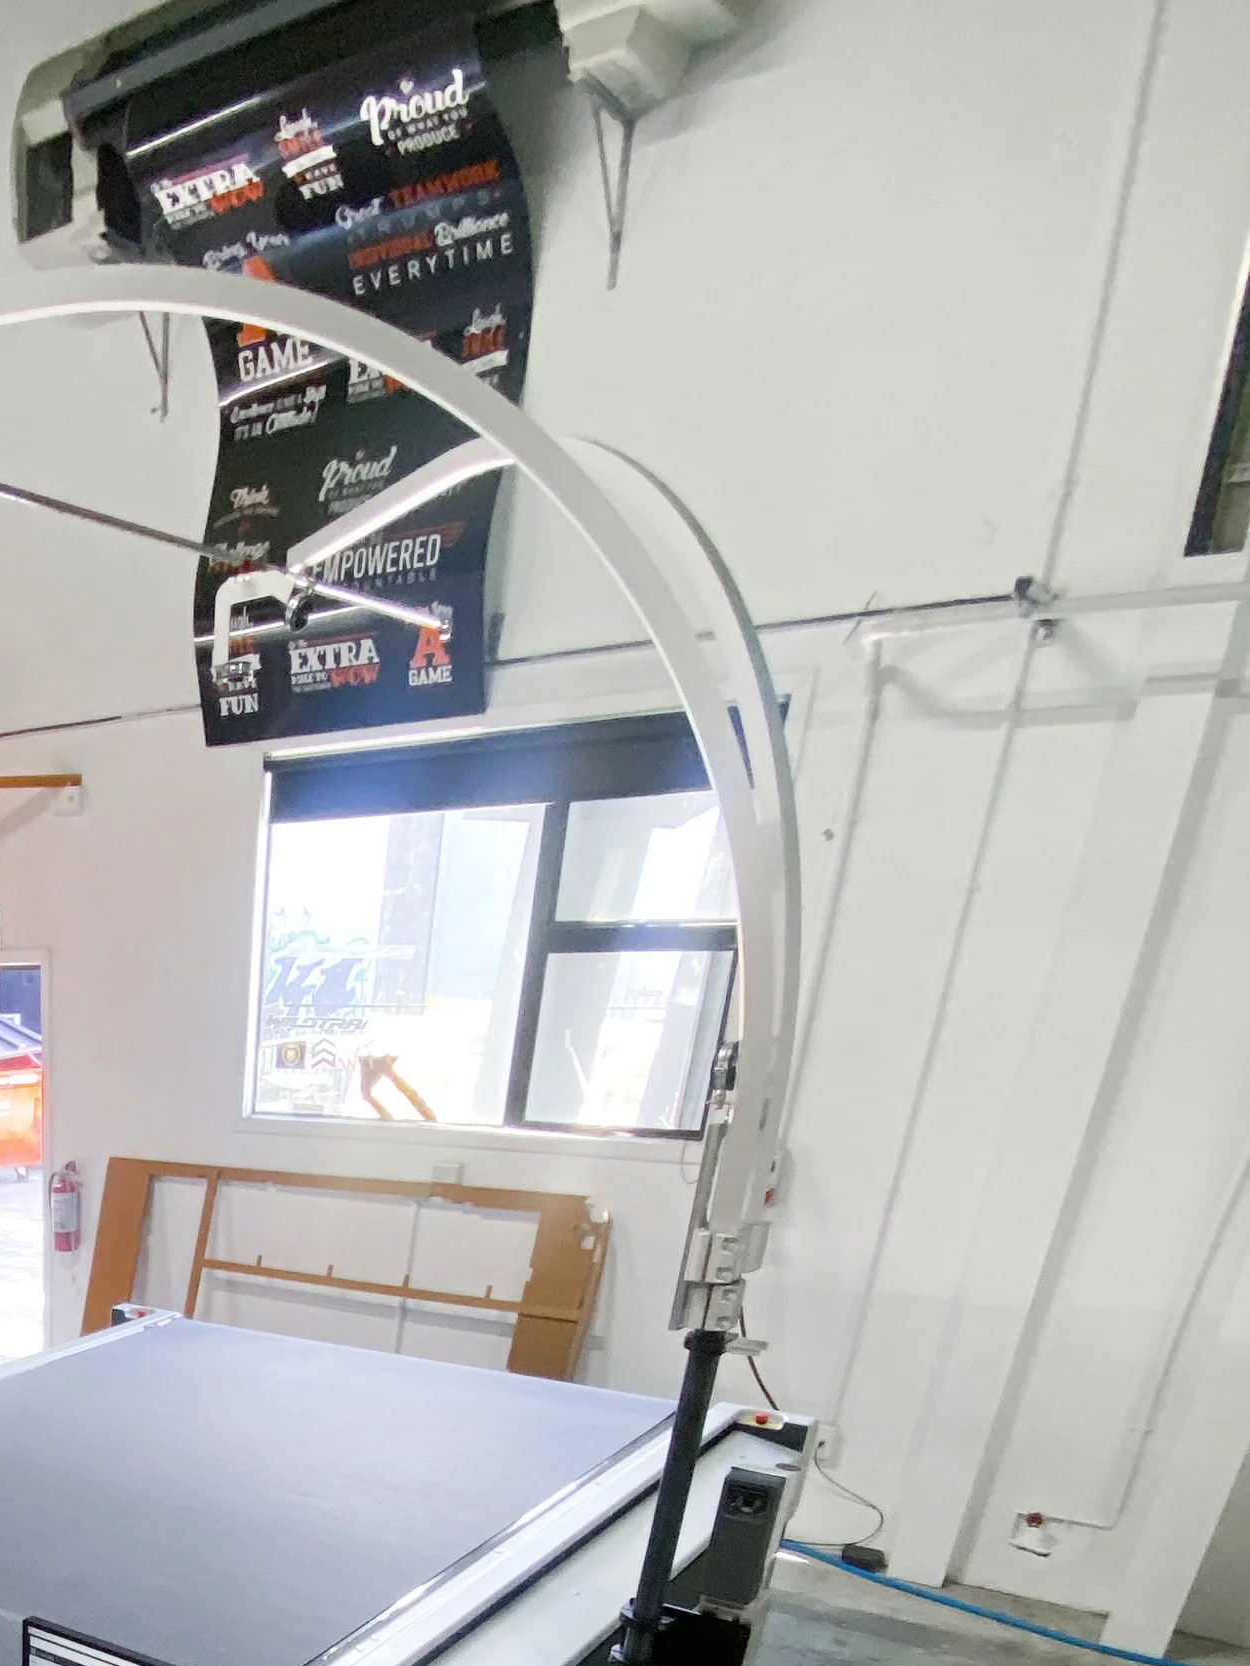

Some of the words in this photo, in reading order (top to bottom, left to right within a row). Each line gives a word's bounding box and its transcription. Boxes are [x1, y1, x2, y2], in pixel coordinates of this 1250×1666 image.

[360, 68, 484, 146] Proud
[154, 162, 260, 215] EXTRA
[352, 232, 514, 297] EVERYTIME
[238, 335, 314, 383] GAME
[318, 444, 399, 503] Proud
[311, 533, 441, 585] EMPOWERED
[290, 637, 381, 675] EXTRA
[408, 664, 453, 687] GAME
[219, 692, 260, 717] FUN
